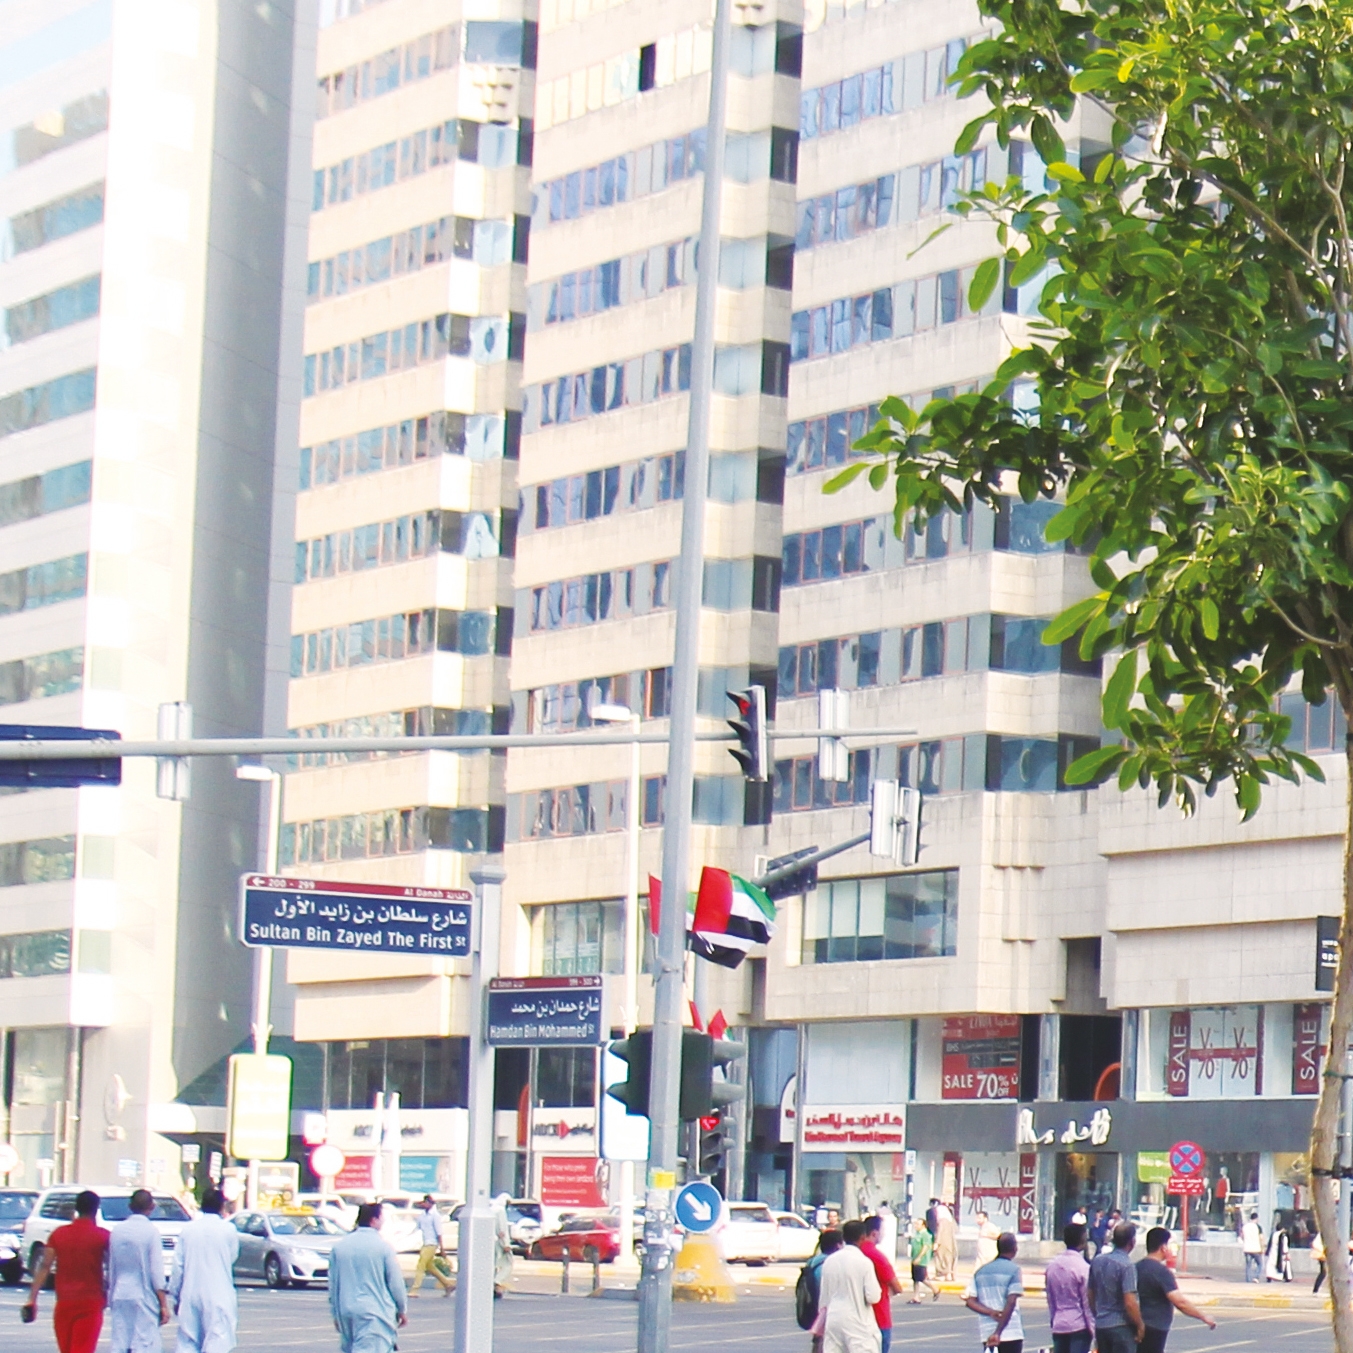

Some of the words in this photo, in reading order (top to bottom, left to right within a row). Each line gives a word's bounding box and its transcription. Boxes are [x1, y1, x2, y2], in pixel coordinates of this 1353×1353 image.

[268, 878, 286, 888] 200
[274, 896, 315, 919] الأول
[319, 903, 350, 921] زايد
[353, 905, 374, 924] بن
[377, 904, 429, 923] سلطان
[431, 910, 467, 931] شارع
[250, 923, 300, 940] Sultan
[306, 926, 331, 942] Bin
[337, 928, 382, 947] Zayed
[388, 931, 415, 947] The
[420, 933, 453, 949] First
[455, 936, 466, 947] St
[511, 1003, 536, 1013] محمد
[536, 1001, 549, 1018] بن
[549, 1000, 578, 1016] حمدان
[578, 996, 599, 1020] شارع
[490, 1025, 524, 1038] Hamdan
[524, 1024, 537, 1038] Bin
[538, 1023, 587, 1038] Mohammed
[1172, 1025, 1187, 1082] SALE
[1300, 1020, 1317, 1081] SALE
[1198, 1059, 1215, 1079] 70
[1231, 1058, 1248, 1079] 70
[944, 1074, 974, 1089] SALE
[1022, 1166, 1036, 1221] SALE
